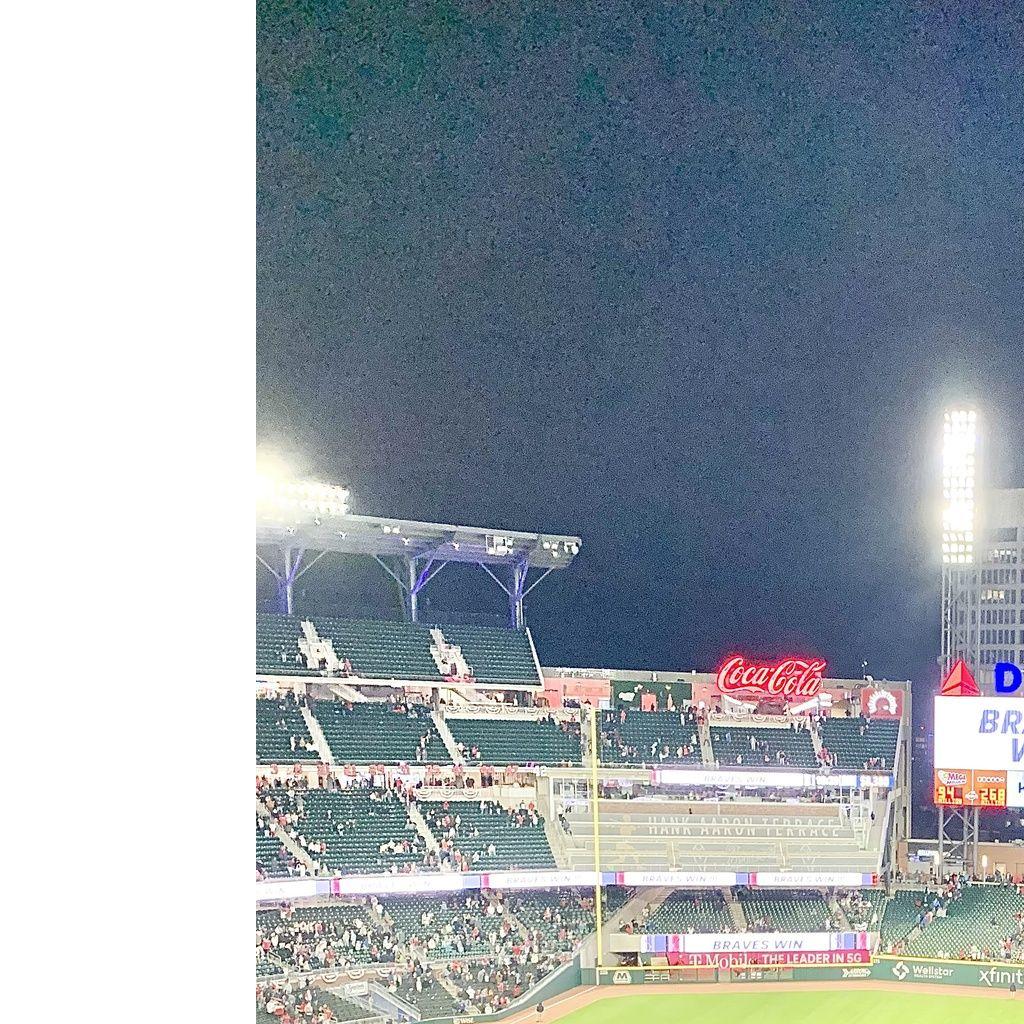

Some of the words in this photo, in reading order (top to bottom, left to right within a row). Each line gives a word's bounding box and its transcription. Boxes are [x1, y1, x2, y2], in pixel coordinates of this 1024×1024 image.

[717, 657, 827, 696] Coca-Cola
[980, 787, 1006, 800] 268
[649, 816, 692, 836] HANK
[700, 816, 756, 837] AARON
[762, 817, 840, 837] TERRACE
[712, 940, 769, 950] BRAVES
[775, 940, 804, 950] WIN
[787, 953, 832, 964] LEADER
[833, 953, 845, 963] IN
[846, 952, 862, 963] 5G
[912, 965, 954, 977] Wellstar
